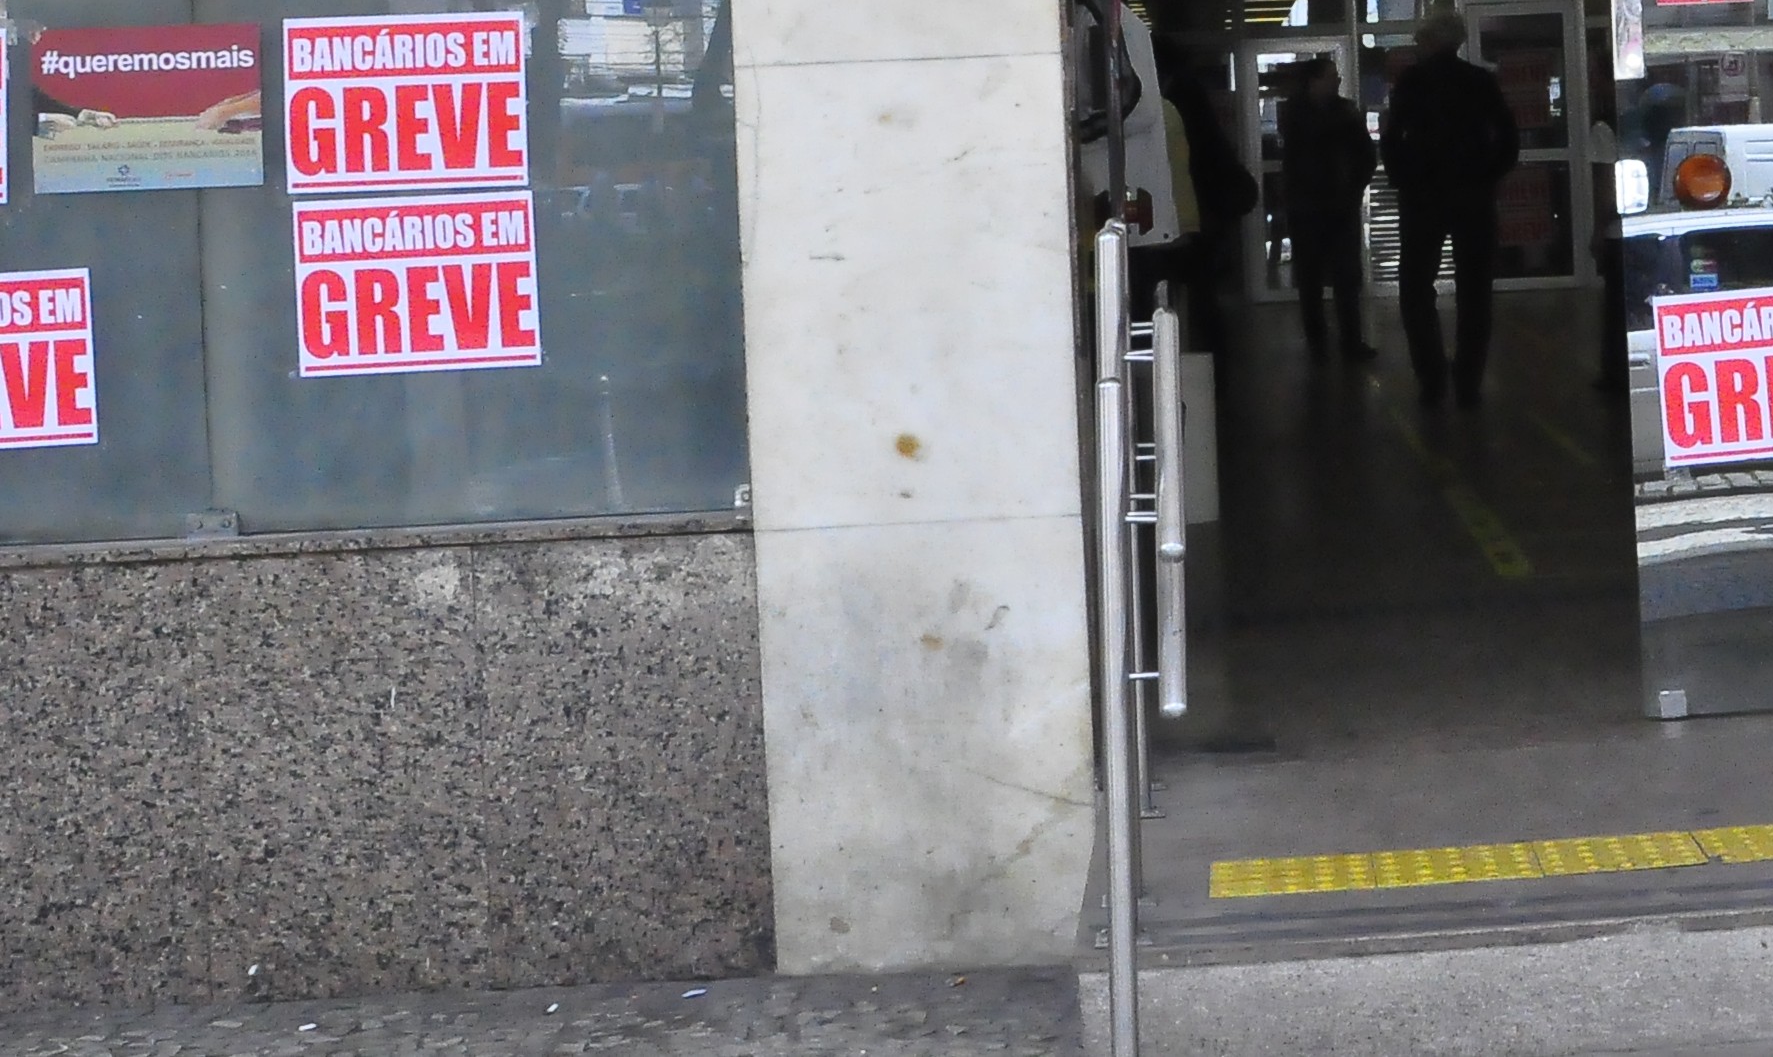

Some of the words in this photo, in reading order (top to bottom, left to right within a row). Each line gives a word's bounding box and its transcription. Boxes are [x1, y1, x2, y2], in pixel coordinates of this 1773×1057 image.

[41, 45, 254, 79] #queremosmais
[292, 29, 466, 70] BANCÁRIOS
[473, 29, 516, 66] EM
[289, 82, 523, 177] GREVE
[302, 211, 475, 254] BANCÁRIOS
[482, 209, 525, 246] EM
[38, 287, 82, 324] EM
[301, 262, 536, 359] GREVE
